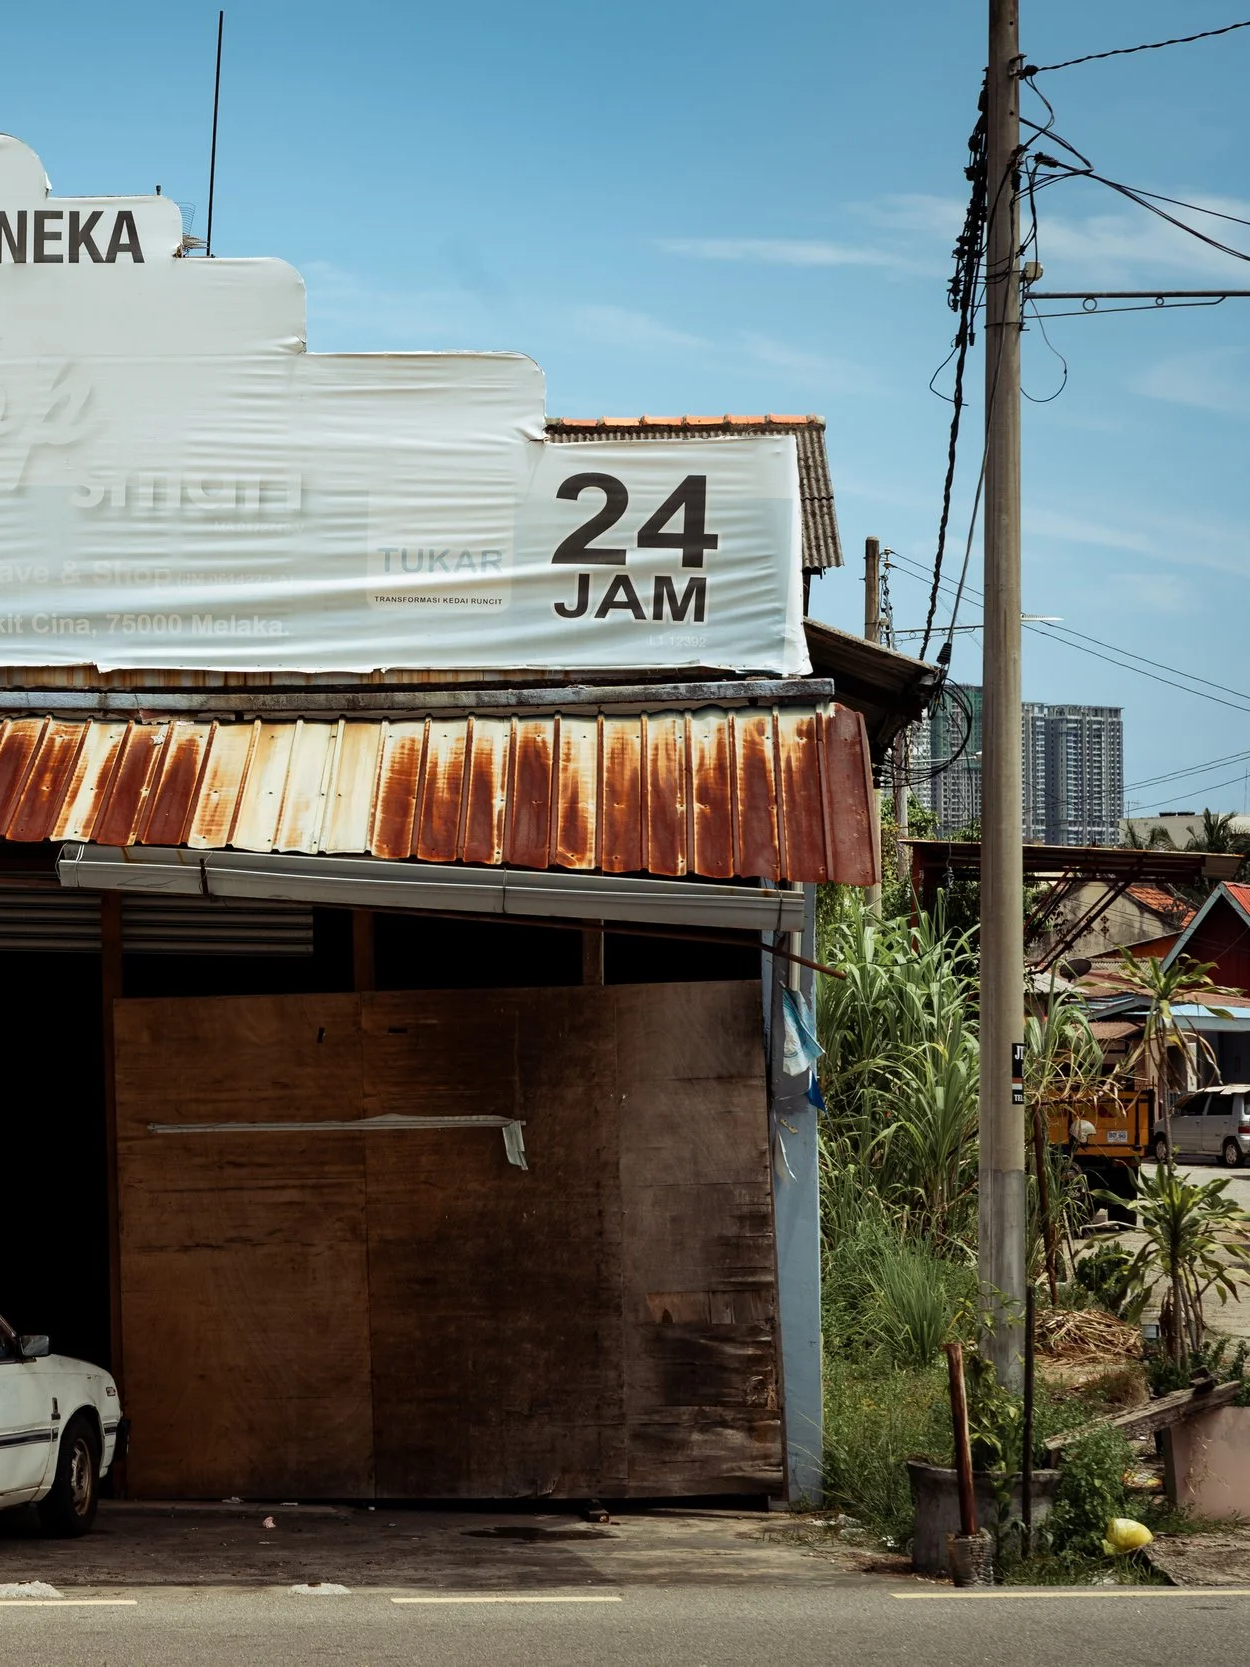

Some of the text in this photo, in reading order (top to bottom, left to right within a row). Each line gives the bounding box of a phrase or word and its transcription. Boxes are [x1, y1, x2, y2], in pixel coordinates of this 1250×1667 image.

[551, 472, 718, 568] 24
[377, 547, 503, 573] TUKAR
[61, 560, 82, 584] &
[93, 560, 172, 589] Shop
[374, 595, 503, 605] TRANSFORMASI KEDAI RUNCIT
[554, 573, 707, 622] JAM
[32, 612, 98, 639] Cina,
[106, 613, 182, 634] 75000
[191, 613, 290, 636] Melaka.
